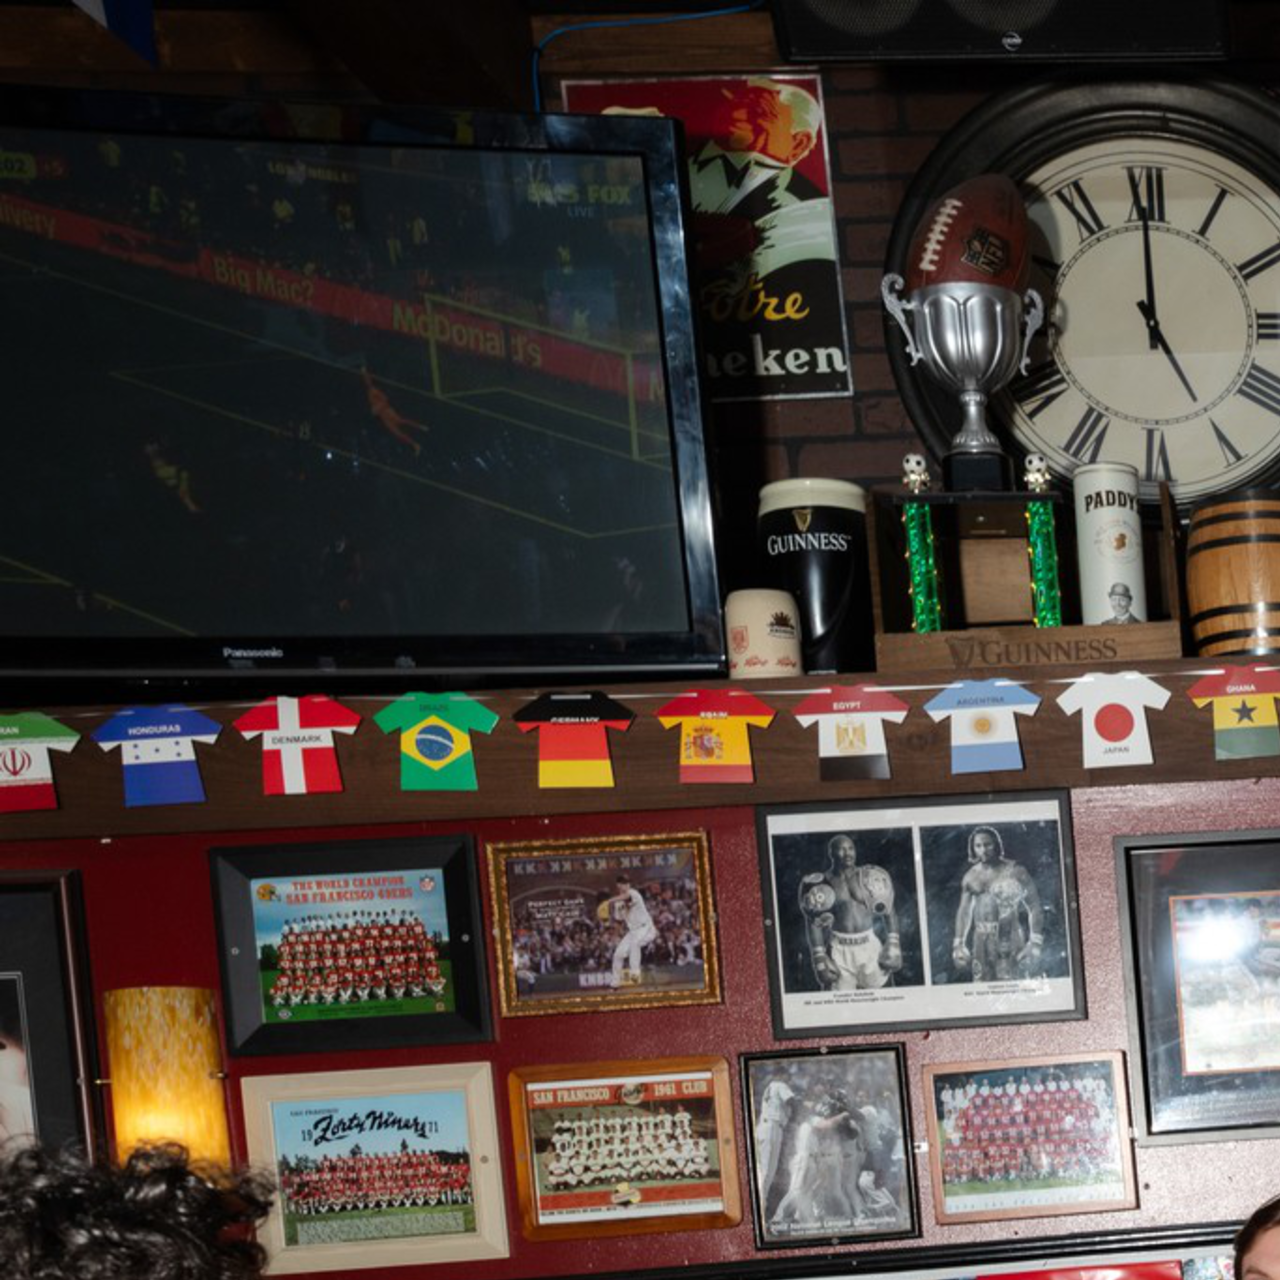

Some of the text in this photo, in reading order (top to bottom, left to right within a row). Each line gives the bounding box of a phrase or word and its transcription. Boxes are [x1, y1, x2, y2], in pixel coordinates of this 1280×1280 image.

[586, 183, 631, 205] FOX
[213, 257, 250, 297] Big
[766, 532, 847, 556] GUINNESS
[222, 646, 284, 659] Panasonic
[981, 637, 1118, 665] GUINNESS
[1226, 683, 1256, 694] GHANA
[832, 700, 862, 712] EGYPT
[127, 724, 182, 737] HONDURAS
[271, 733, 323, 746] DENMARK
[1102, 745, 1131, 756] JAPAN
[534, 1080, 707, 1104] SAN FRANCISCO 1961 CLUB
